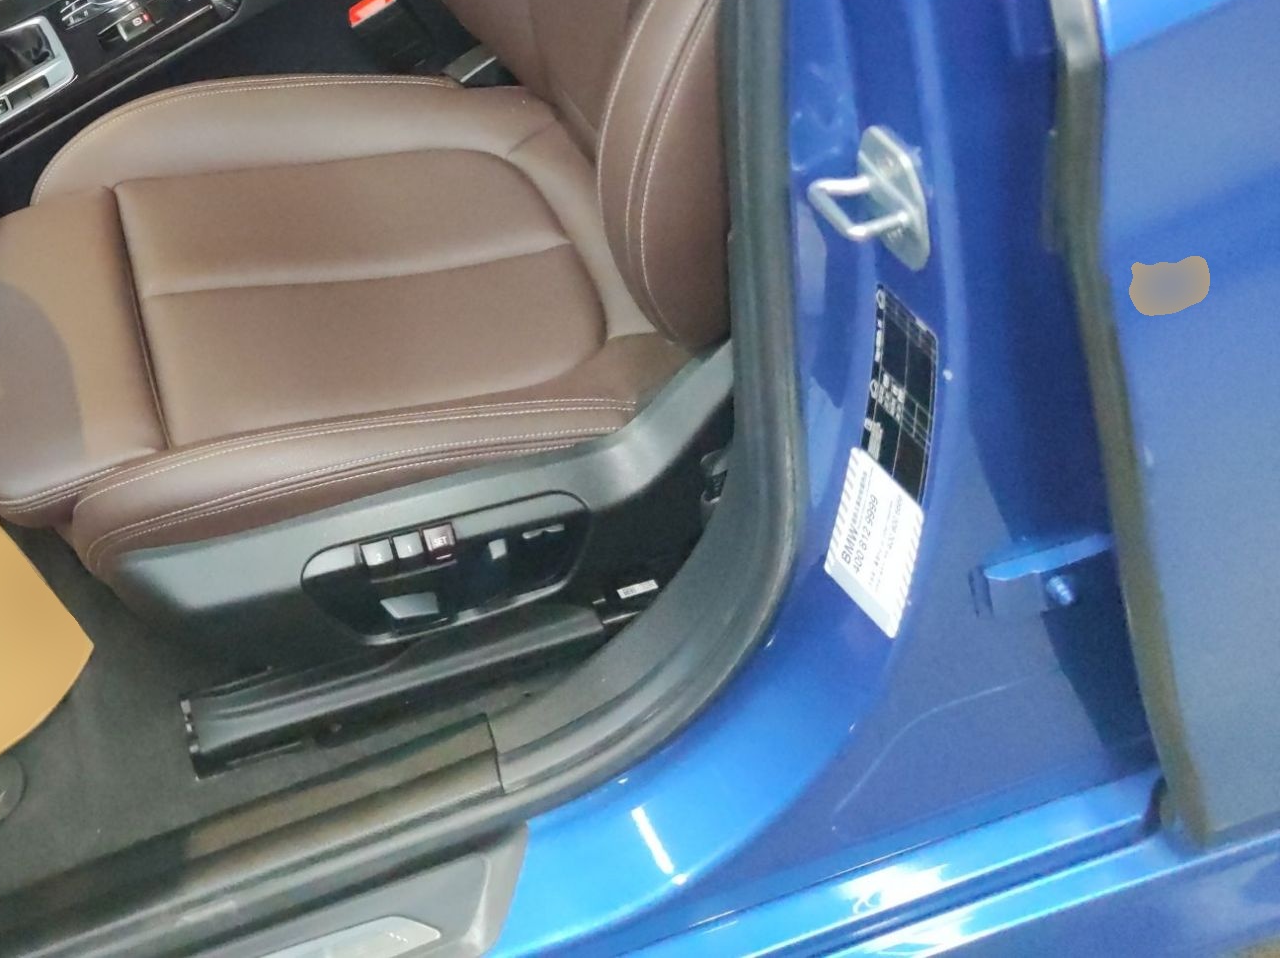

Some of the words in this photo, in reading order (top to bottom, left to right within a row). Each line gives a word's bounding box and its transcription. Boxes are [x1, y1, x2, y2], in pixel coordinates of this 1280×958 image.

[432, 536, 448, 548] SET
[841, 526, 858, 564] BMW
[853, 550, 864, 573] 400
[859, 526, 871, 551] 812
[865, 494, 878, 527] 9999
